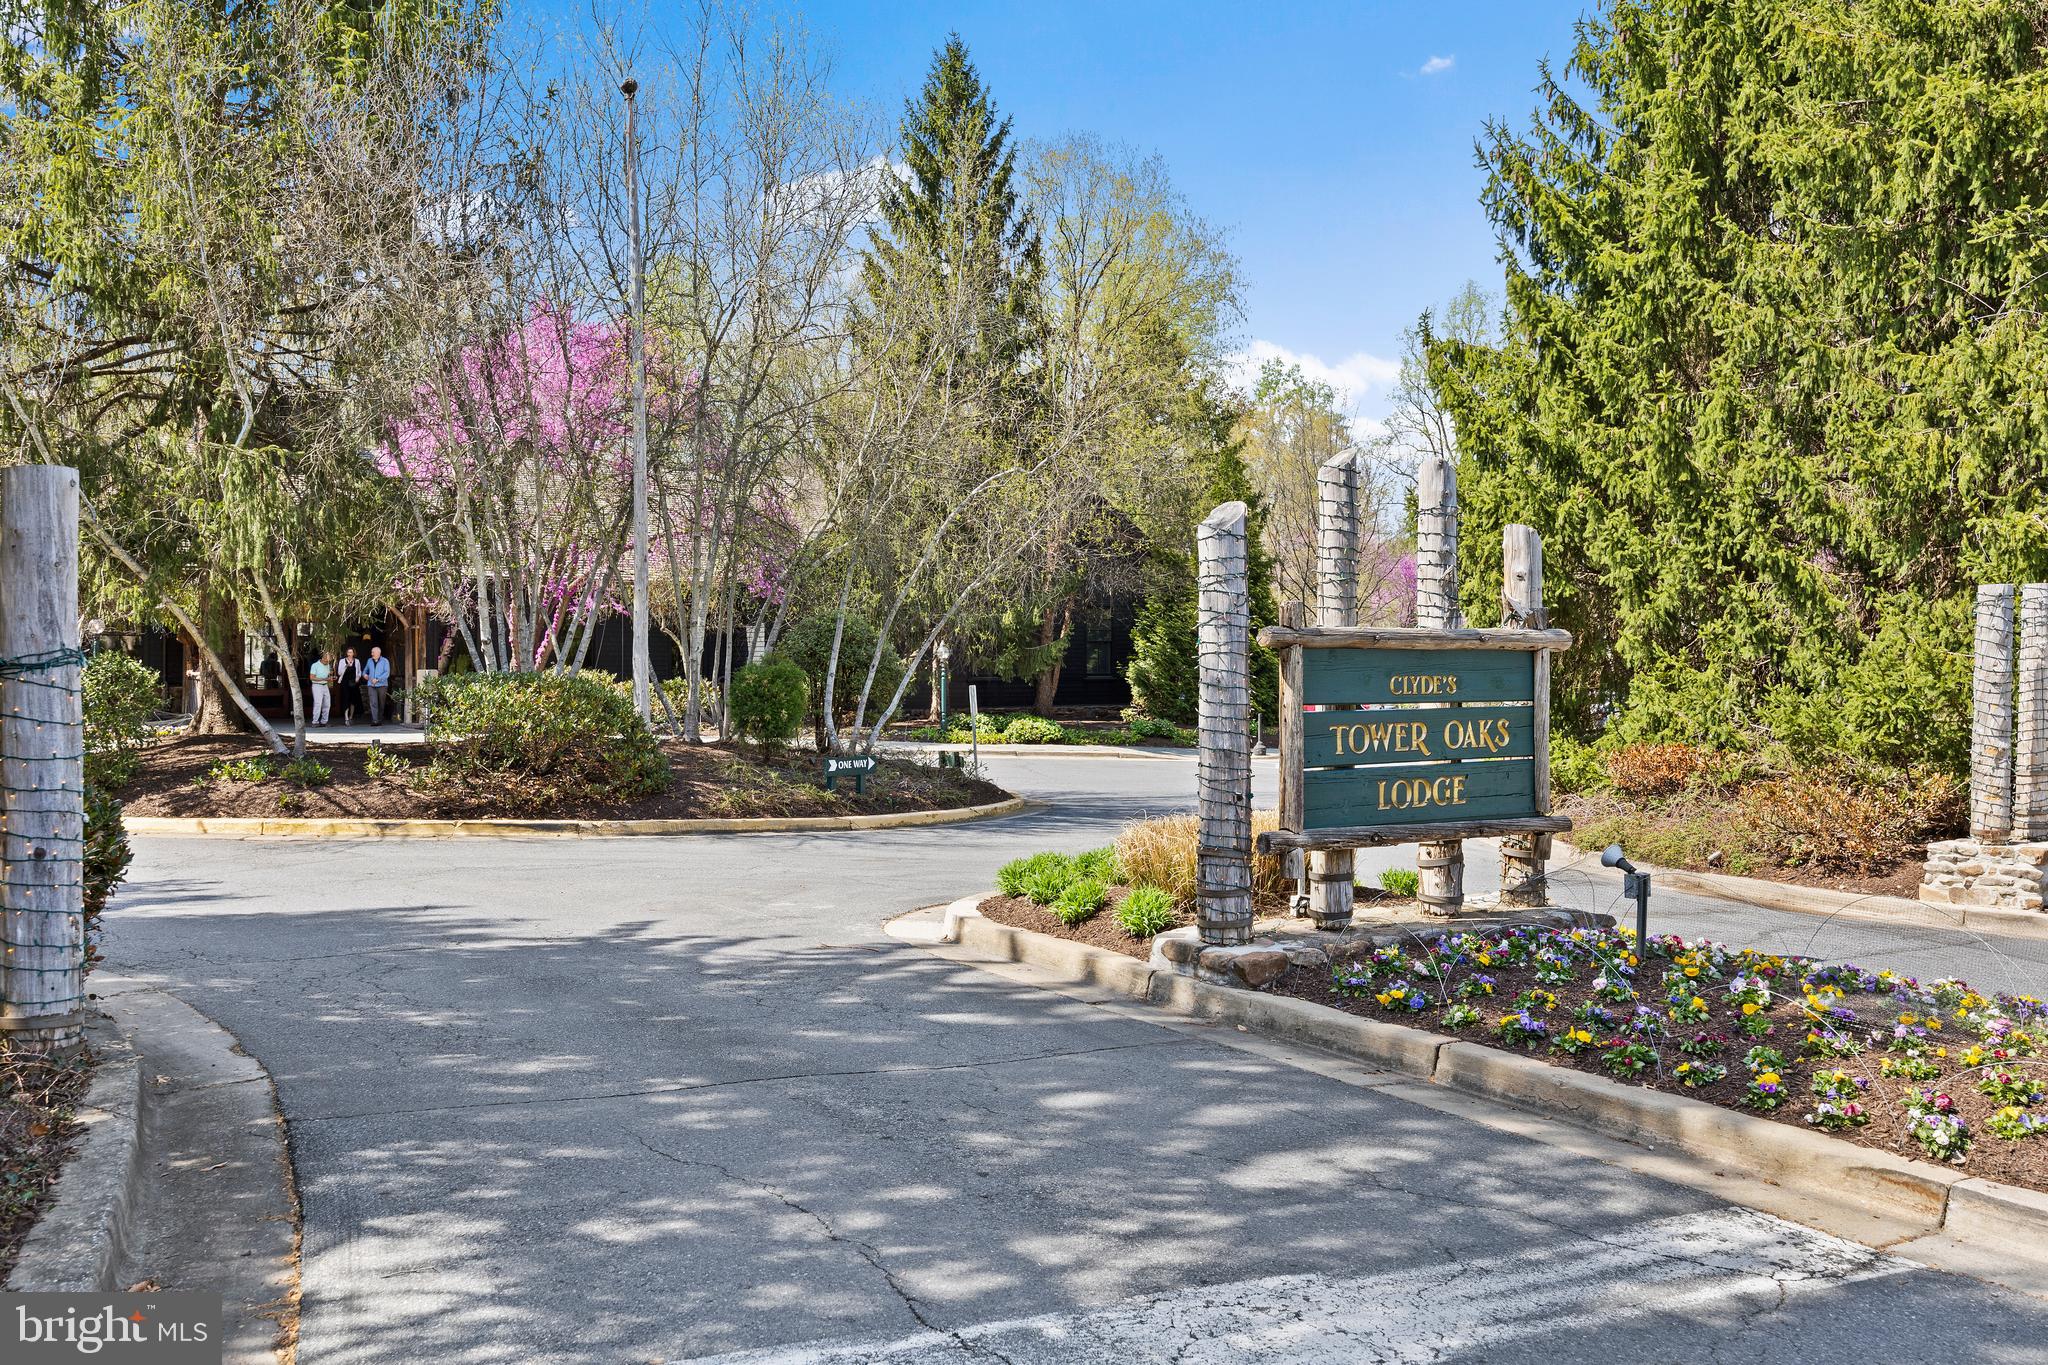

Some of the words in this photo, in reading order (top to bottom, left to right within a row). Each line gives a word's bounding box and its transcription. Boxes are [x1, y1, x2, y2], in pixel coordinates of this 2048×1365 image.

[1389, 674, 1457, 696] CLYDE'S
[1329, 721, 1432, 757] TOWER
[1443, 718, 1510, 753] OAKS
[838, 760, 852, 770] ONE
[853, 759, 868, 769] WAY
[1377, 775, 1467, 811] LODGE
